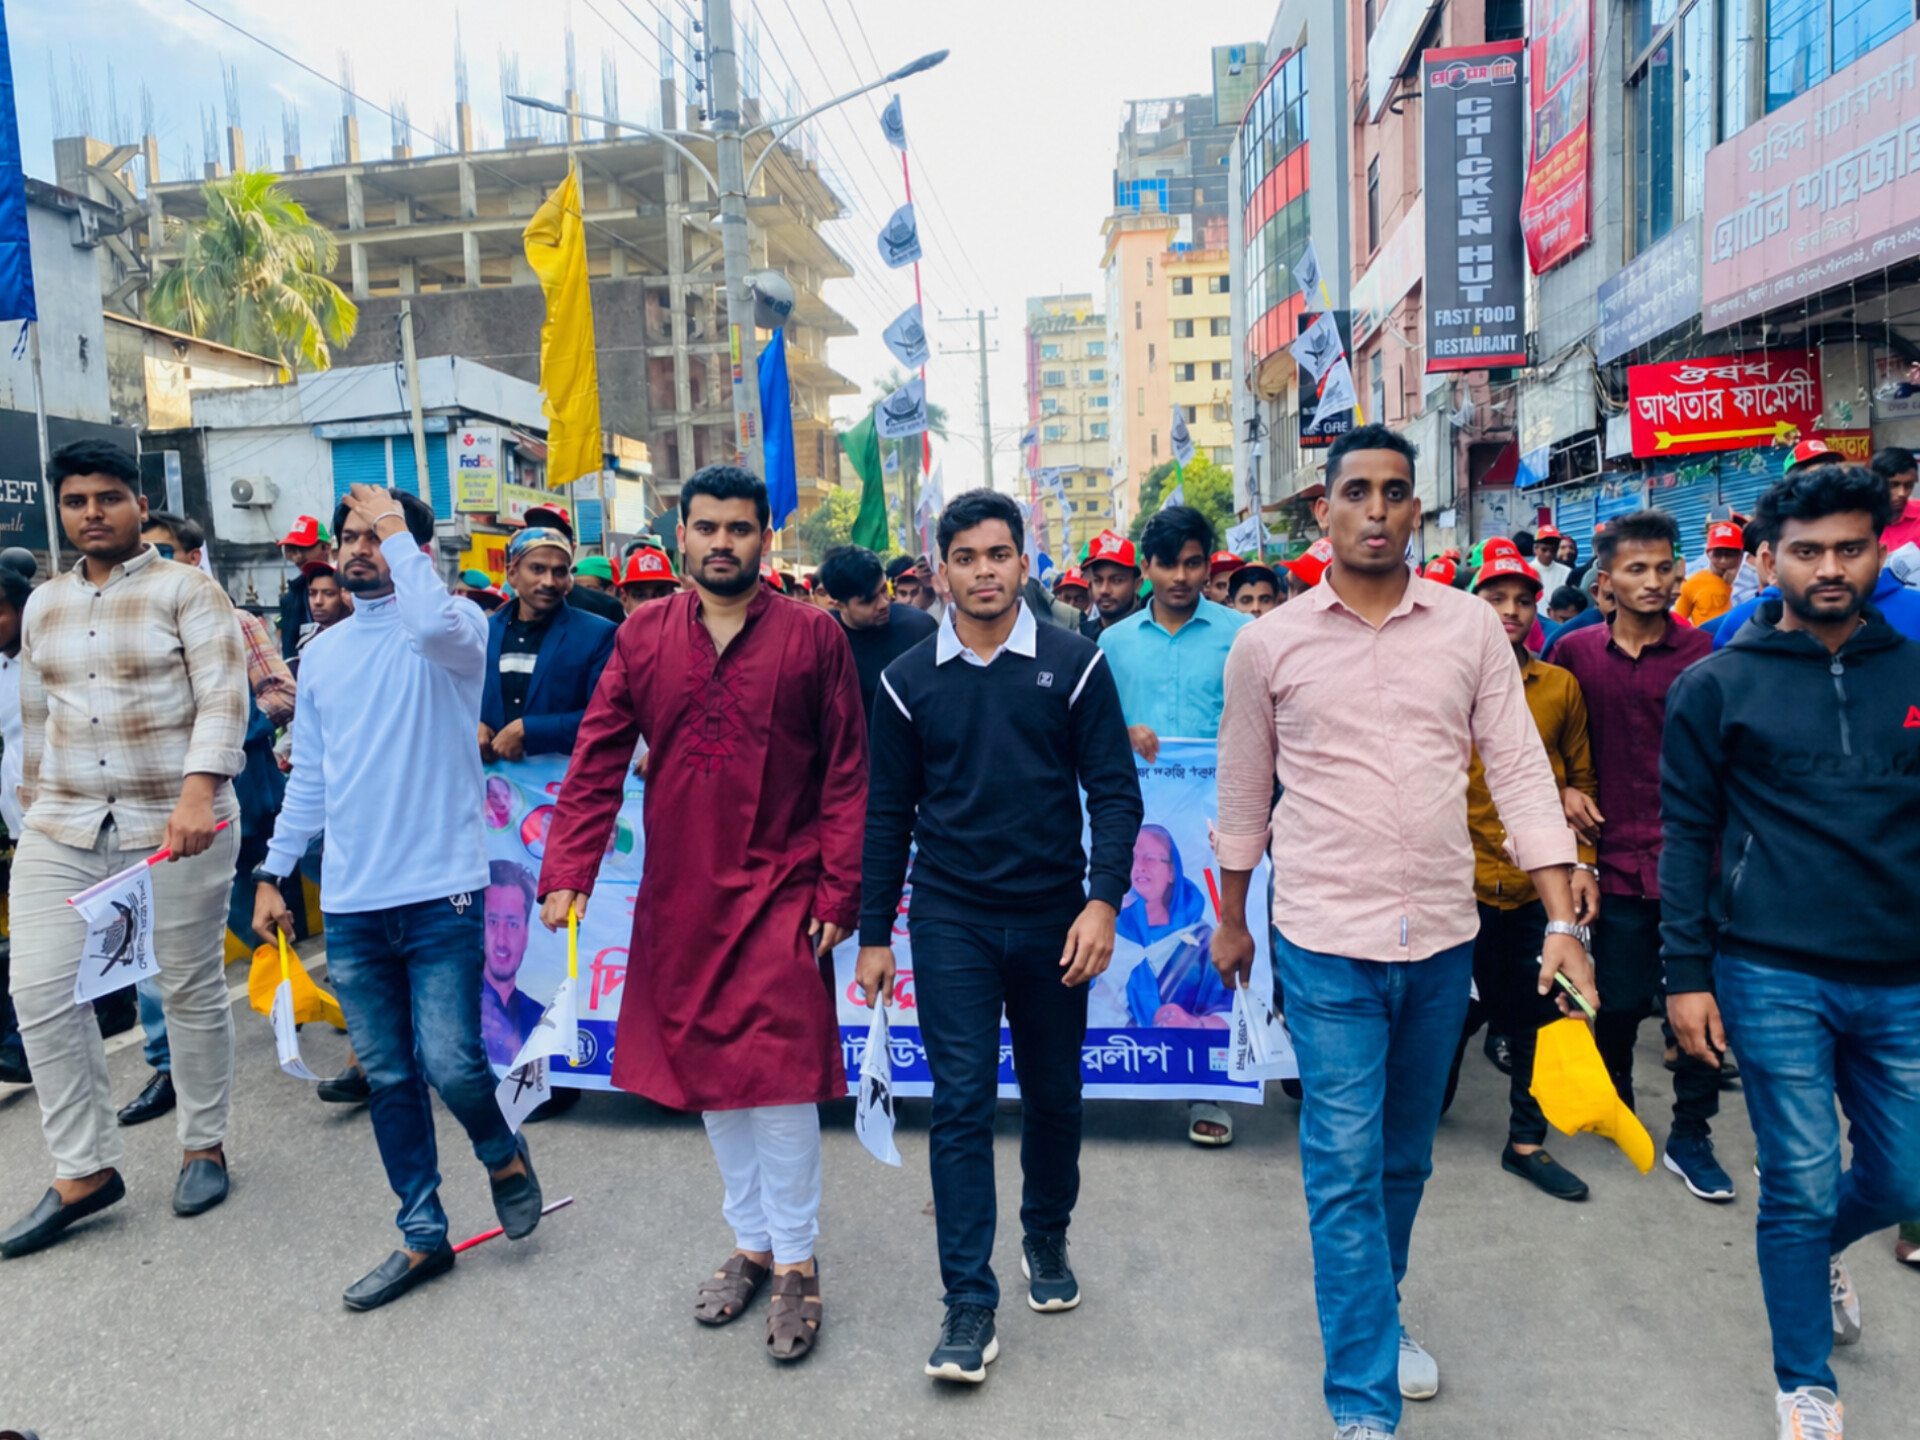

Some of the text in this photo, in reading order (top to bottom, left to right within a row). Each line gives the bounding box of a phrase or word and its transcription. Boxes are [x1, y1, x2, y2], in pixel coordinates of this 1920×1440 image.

[1456, 96, 1494, 237] CHICKEN
[1458, 244, 1494, 303] HUT
[1434, 305, 1516, 327] FAST FOOD
[1434, 334, 1518, 355] RESTAURANT
[1635, 367, 1816, 426] আখতার ফার্মেসী
[459, 454, 494, 468] FedEx
[0, 478, 38, 505] ET
